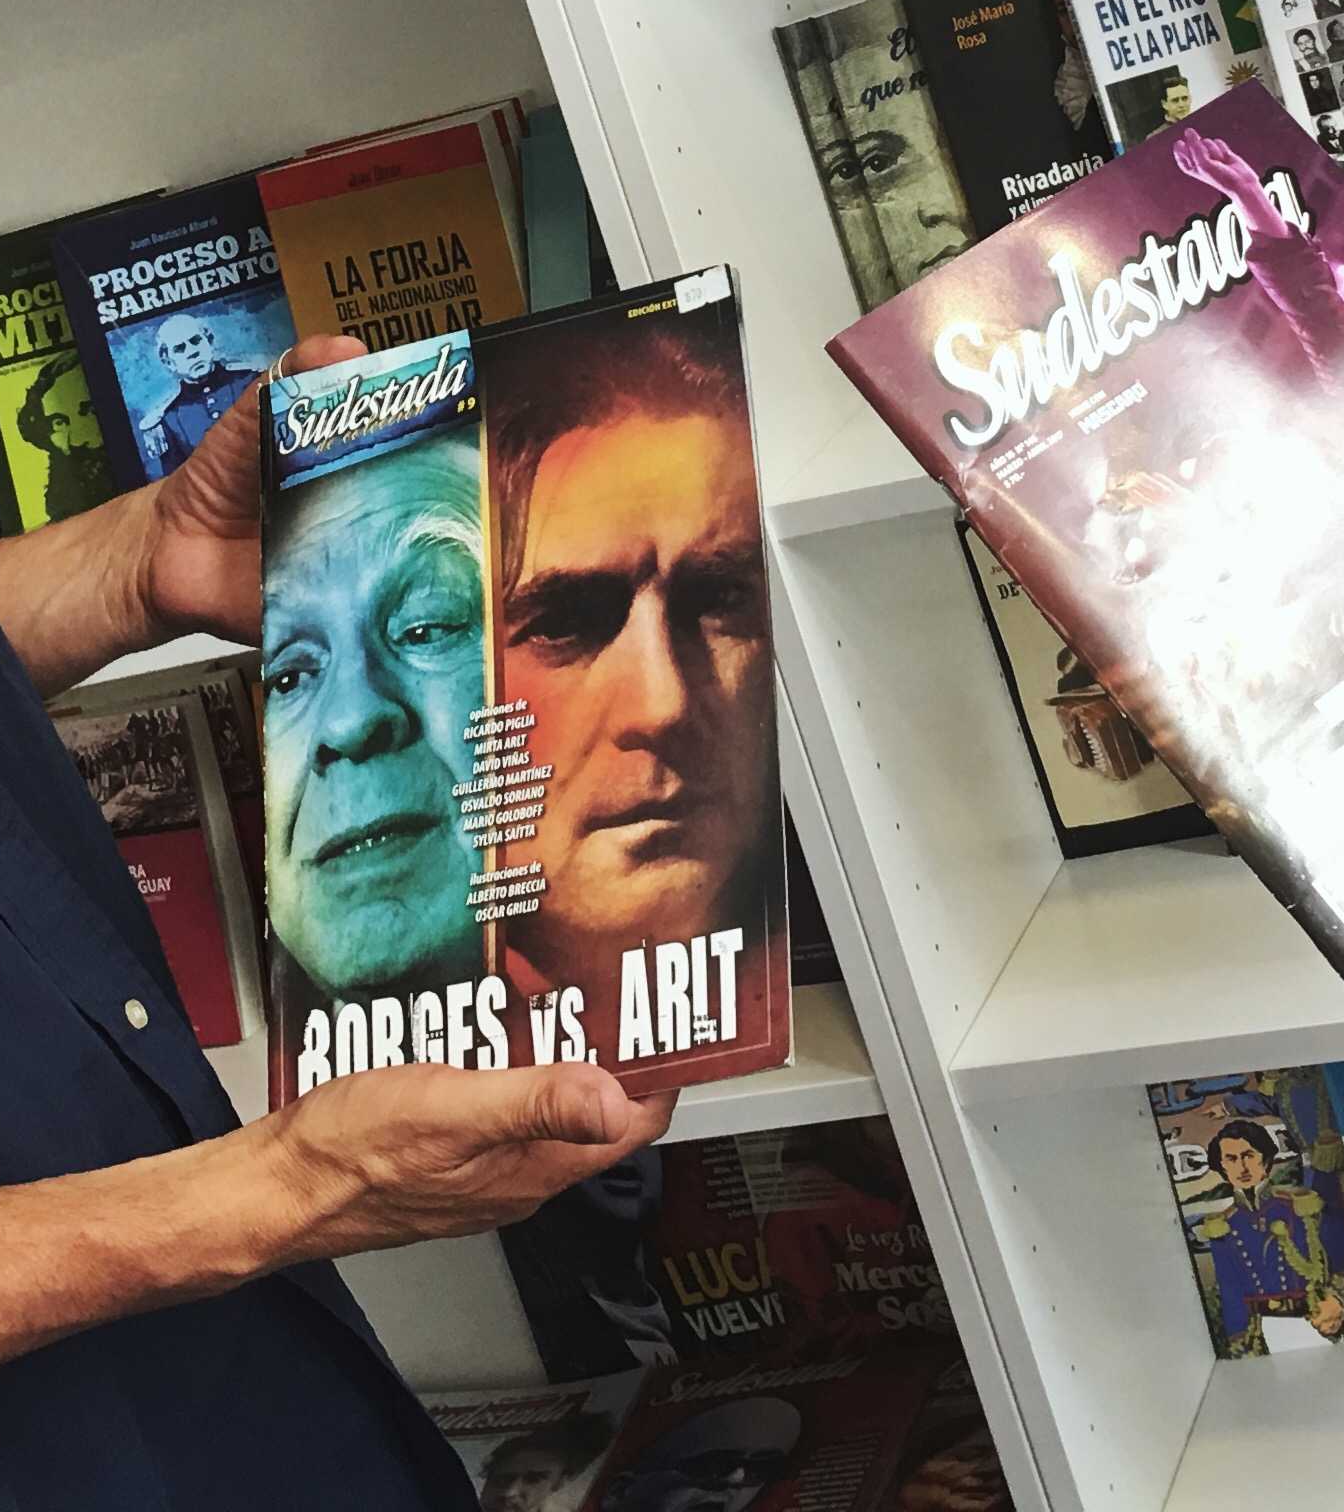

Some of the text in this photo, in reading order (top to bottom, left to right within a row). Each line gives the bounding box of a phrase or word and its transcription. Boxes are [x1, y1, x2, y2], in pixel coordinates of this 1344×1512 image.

[952, 0, 1015, 32] José María
[957, 31, 987, 50] Rosa
[1106, 12, 1221, 72] DE LA PLATA
[1001, 152, 1105, 201] Rivadavia
[88, 234, 240, 300] PROCESO
[325, 232, 472, 300] LA FORJA
[97, 251, 281, 324] SARMIENTO
[336, 275, 478, 323] DEL NACIONALISMO
[279, 344, 467, 455] Sudestada
[469, 698, 527, 721] opiniones de
[464, 714, 535, 739] RICARDO PIGLIA
[474, 740, 503, 756] MIRTA
[473, 751, 529, 775] DAVID VIÑAS
[452, 765, 553, 797] GUILLERMO MARTÍNEZ
[460, 784, 545, 814] OSVALDO SORIANO
[463, 804, 544, 831] MARIO GOLOBOFF
[473, 831, 503, 849] SYLVIA
[533, 861, 542, 873] de
[466, 878, 546, 906] ALBERTO BRECCIA
[475, 898, 539, 923] OSCAR GRILLO
